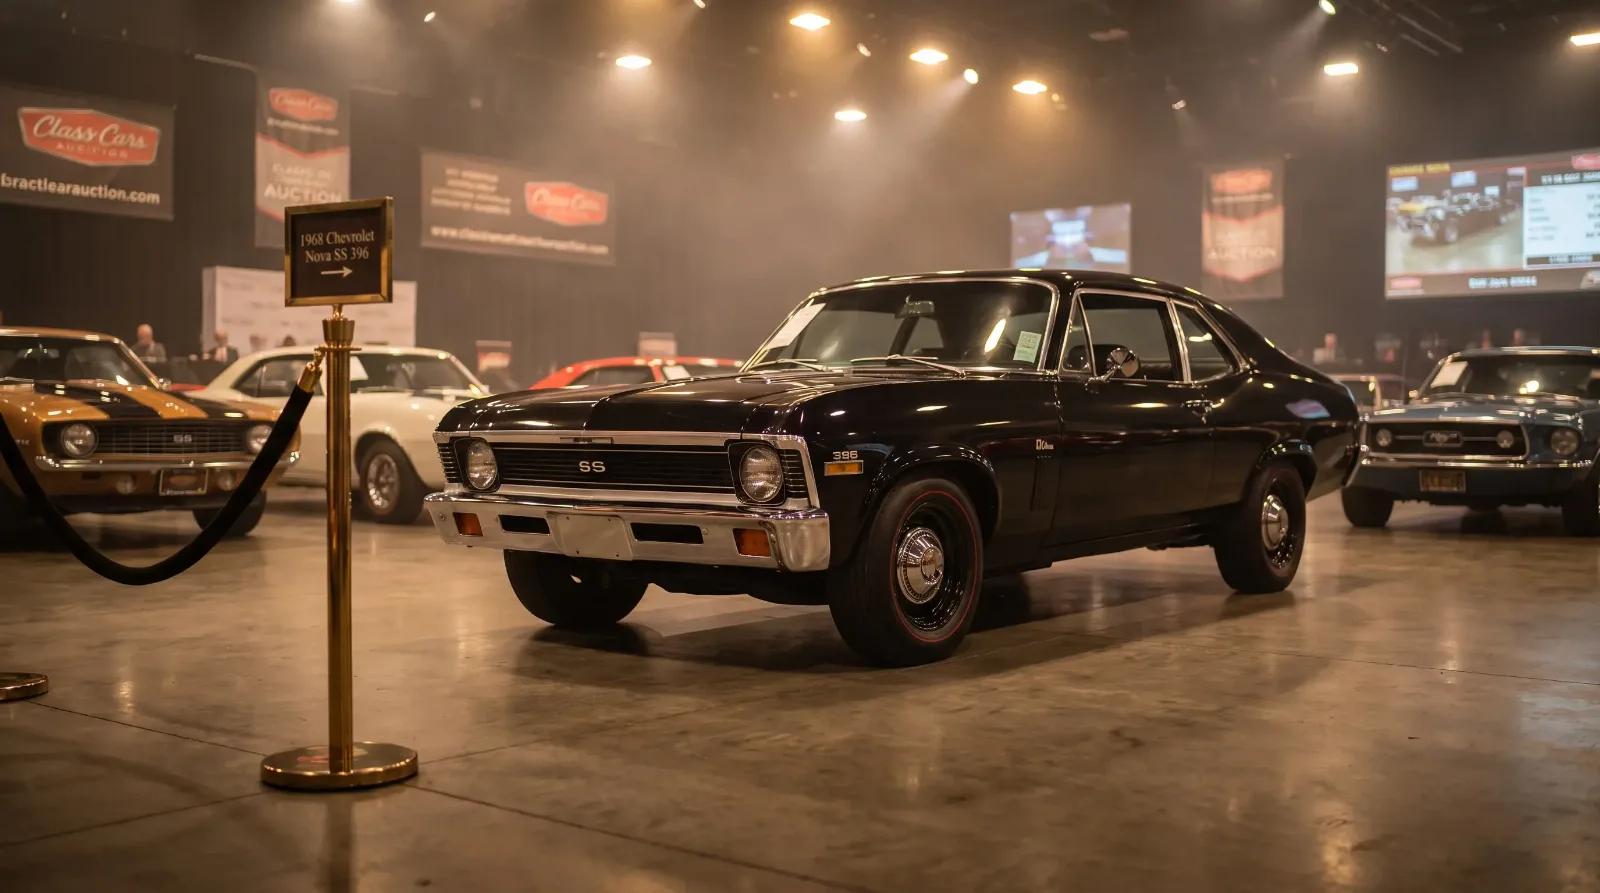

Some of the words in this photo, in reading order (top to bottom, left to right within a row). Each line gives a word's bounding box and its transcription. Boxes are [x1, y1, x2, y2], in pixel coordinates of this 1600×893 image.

[33, 114, 98, 143] Class
[99, 123, 149, 150] Cars
[300, 232, 325, 248] 1968
[326, 228, 376, 245] Chevrolet
[304, 249, 333, 264] Nova
[333, 247, 349, 262] SS
[349, 245, 370, 261] 396
[832, 450, 859, 460] 396
[578, 460, 607, 473] SS
